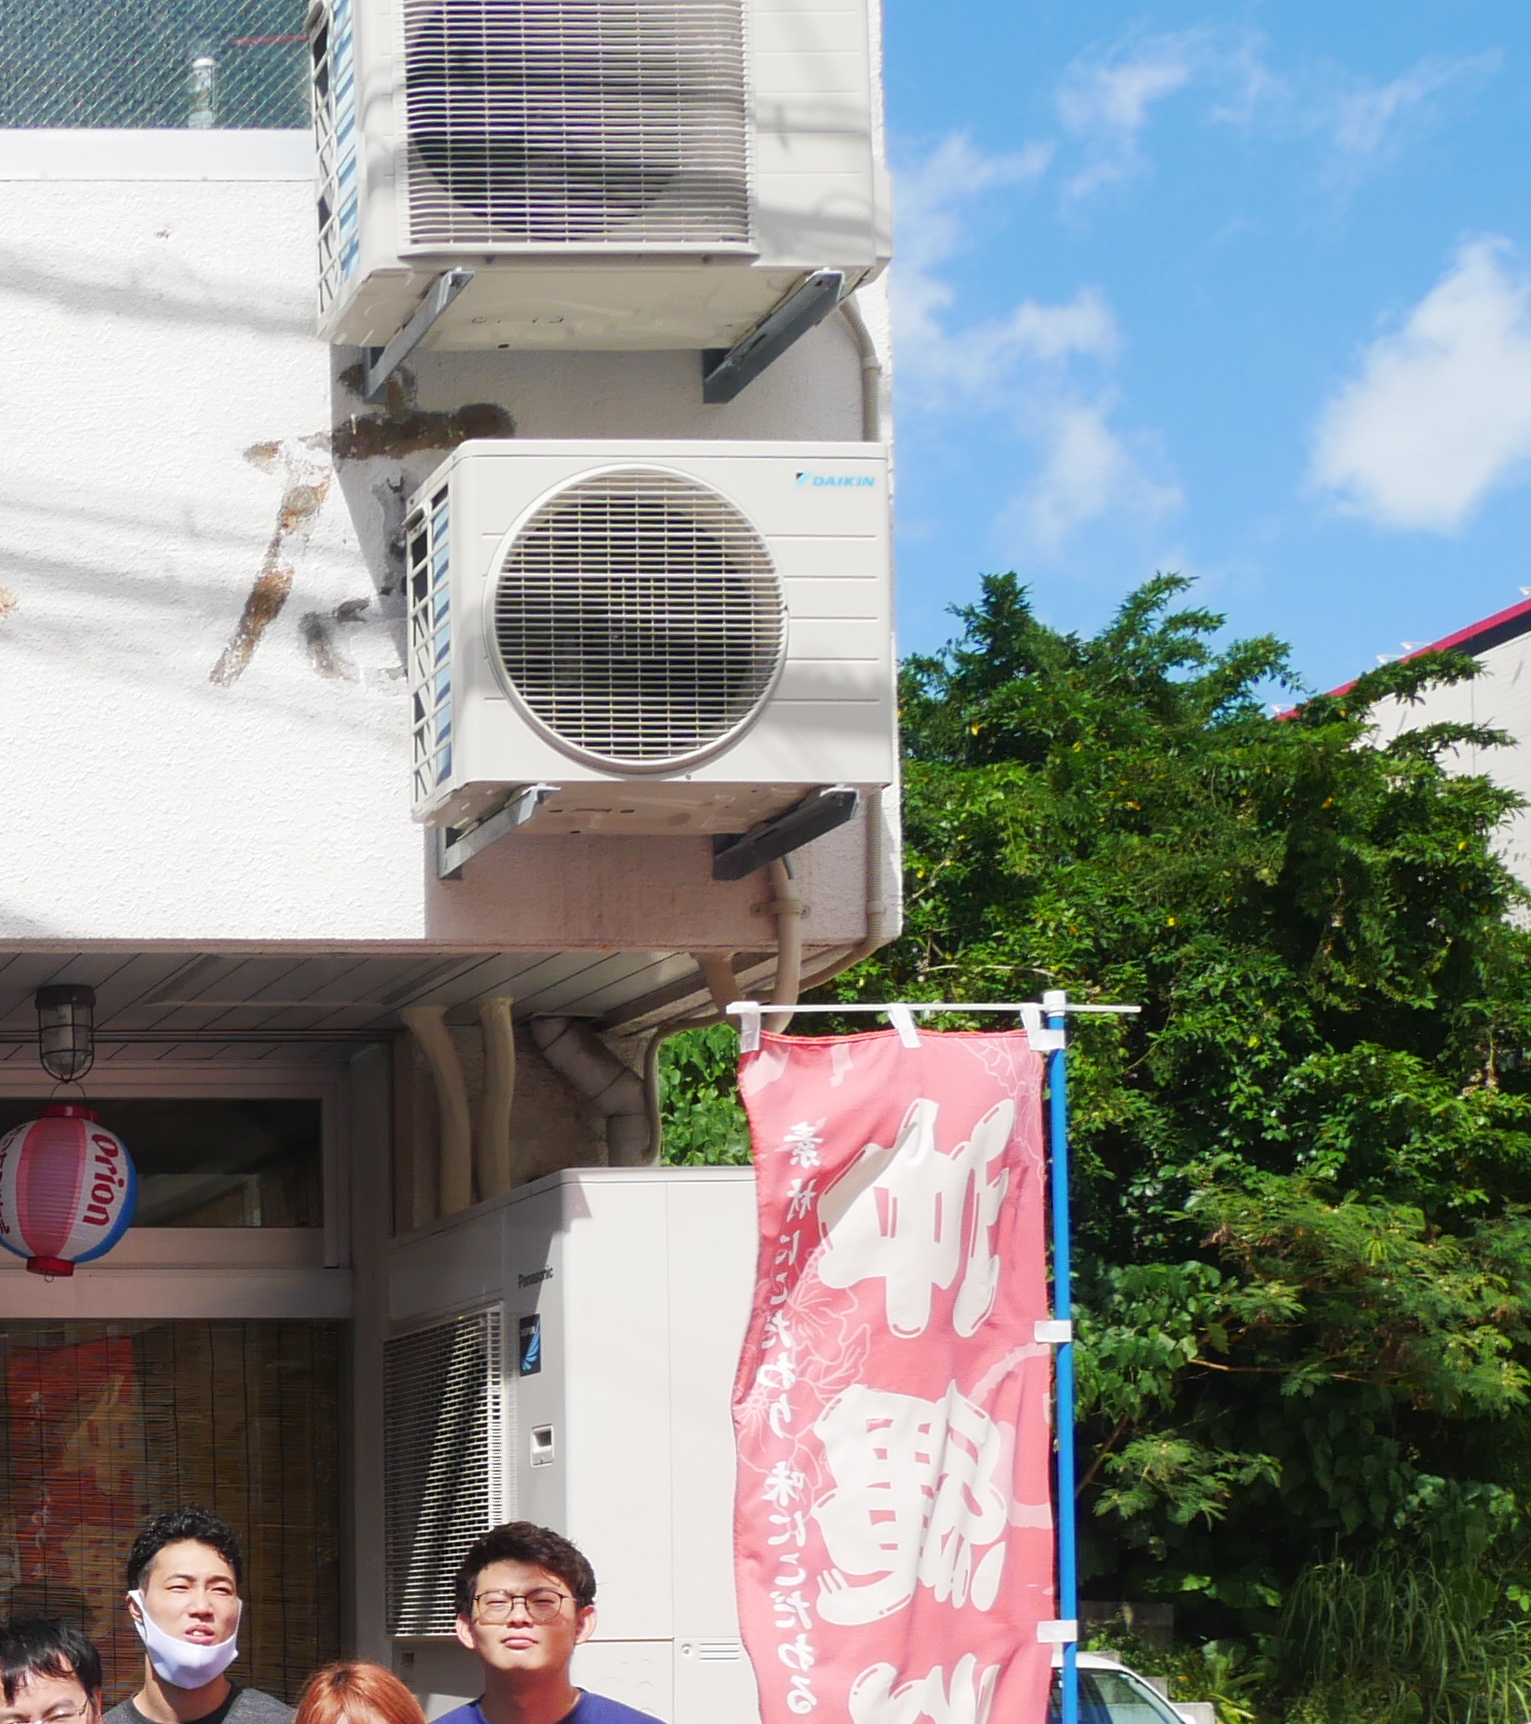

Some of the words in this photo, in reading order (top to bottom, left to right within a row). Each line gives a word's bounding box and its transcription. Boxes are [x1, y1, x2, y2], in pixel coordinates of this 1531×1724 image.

[812, 476, 875, 486] DAIKIN
[82, 1134, 124, 1226] Orion
[518, 1265, 553, 1288] Panasonic
